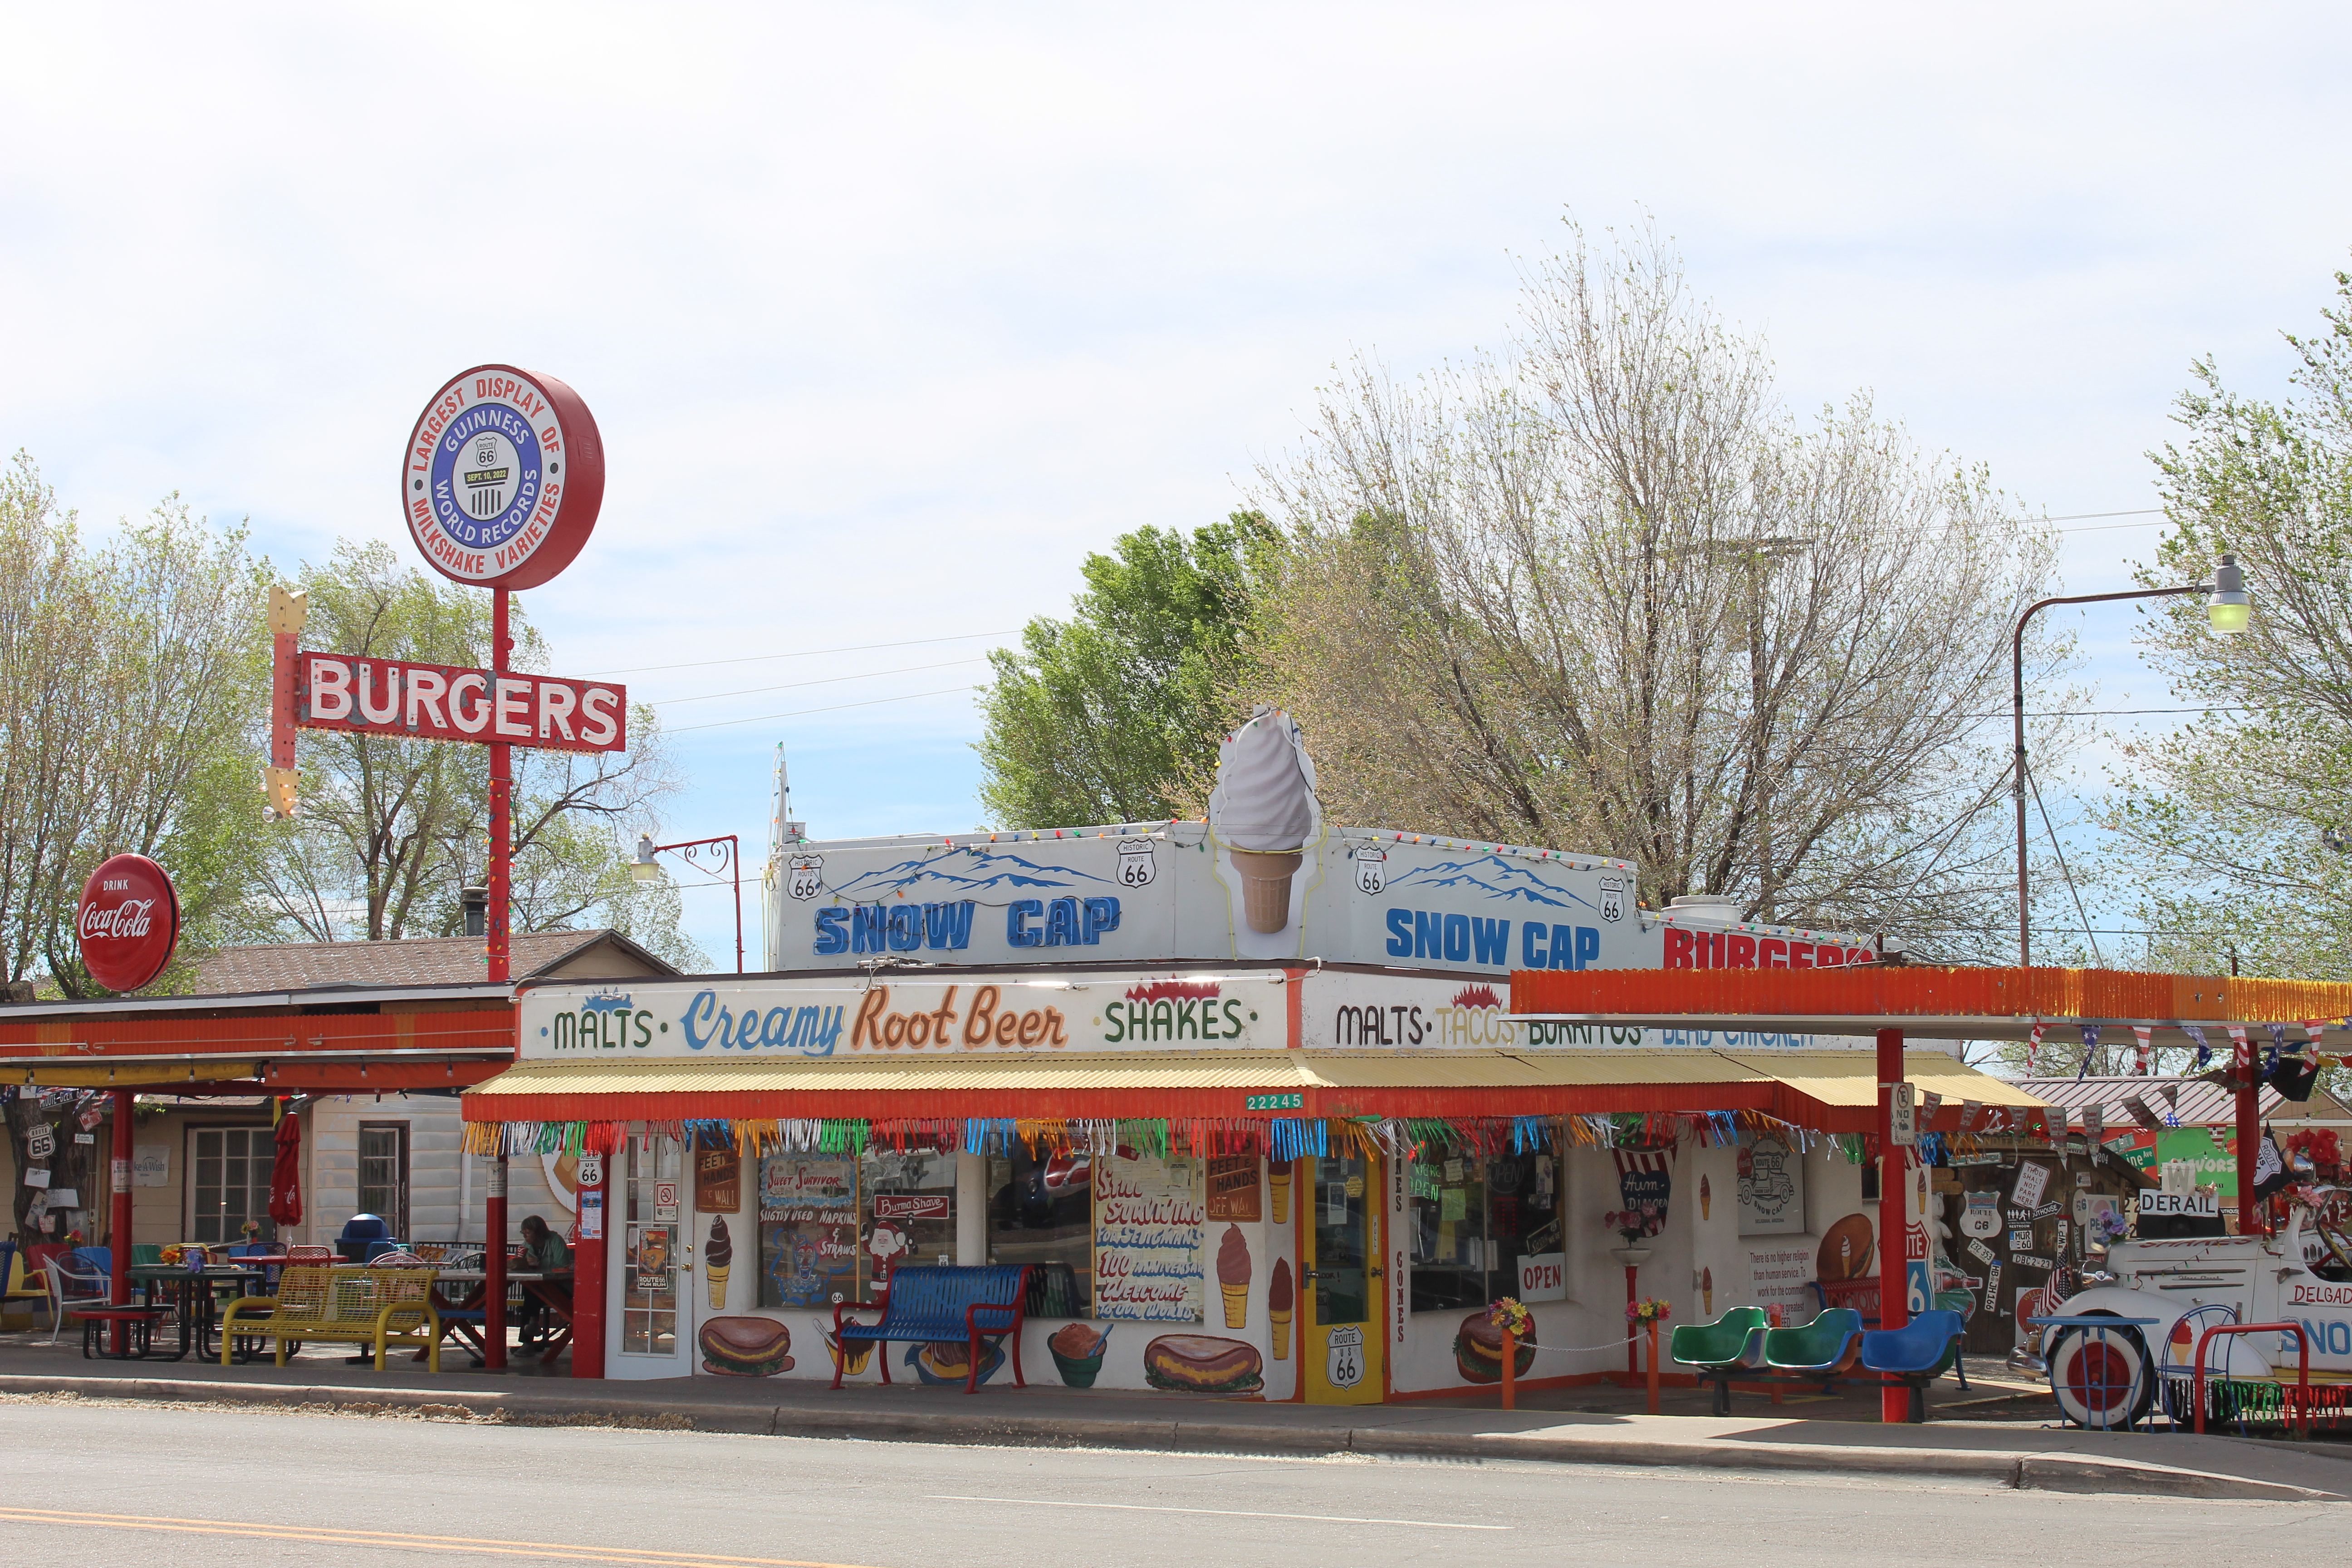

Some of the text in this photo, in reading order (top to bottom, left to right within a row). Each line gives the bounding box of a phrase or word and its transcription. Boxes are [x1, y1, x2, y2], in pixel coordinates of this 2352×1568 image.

[412, 378, 560, 472] LARGEST DISPLAY OF
[445, 409, 529, 452] GUINNESS
[479, 451, 494, 463] 66
[467, 470, 506, 482] SEPT. 10, 2022
[436, 469, 537, 544] WORLD RECORDS
[413, 483, 559, 573] MILKSHAKE VARIETIES
[310, 659, 618, 745] BURGERS
[1123, 843, 1149, 851] HISTORIC
[1360, 851, 1381, 859] HISTORIC
[1127, 856, 1145, 864] ROUTE
[1125, 865, 1147, 883] 66
[1362, 871, 1380, 890] 66
[103, 879, 128, 891] DRINK
[795, 878, 814, 897] 66
[80, 898, 156, 939] Coca-Cola
[1604, 901, 1619, 919] 66
[813, 896, 1122, 956] SNOW CAP
[1386, 908, 1599, 971] SNOW CAP
[554, 984, 1242, 1056] MALTS Creamy Root Beer SHAKES
[1336, 1005, 1423, 1045] MALTS
[1436, 1007, 1515, 1045] TACOS
[1248, 1094, 1301, 1110] 22245
[1897, 1110, 1909, 1118] NO
[32, 1137, 50, 1154] 66
[698, 1153, 725, 1171] FEET
[1755, 1156, 1780, 1168] ROUTE 66
[2125, 1150, 2153, 1167] ine Ave
[2262, 1144, 2277, 1168] ROUTE
[582, 1168, 598, 1181] 66
[1210, 1156, 1254, 1176] FEET &
[1489, 1163, 1521, 1182] OPEN
[2027, 1166, 2043, 1177] THOU
[704, 1166, 736, 1186] HANDS
[767, 1166, 841, 1190] SWEET SURVIVOR
[1217, 1170, 1258, 1193] HANDS
[2022, 1172, 2042, 1185] SHALT
[2167, 1165, 2190, 1192] W
[2019, 1187, 2036, 1199] PARK
[2024, 1181, 2037, 1190] NOT
[715, 1190, 736, 1205] WALL
[880, 1197, 944, 1216] Burma Shave
[1208, 1197, 1227, 1214] OFF
[2017, 1194, 2034, 1206] HERE
[2142, 1194, 2216, 1214] DERAIL
[1104, 1198, 1204, 1226] SURVIVING
[1754, 1200, 1783, 1215] SNOW CAP
[791, 1210, 814, 1222] USED
[818, 1210, 857, 1225] NAPKINS
[1096, 1226, 1118, 1248] FOR
[2015, 1230, 2030, 1240] MÜR
[820, 1241, 857, 1259] STRAWS
[1970, 1240, 1993, 1261] 232 353
[2021, 1240, 2032, 1249] 60
[1099, 1251, 1132, 1278] 100
[1750, 1250, 1809, 1264] There is no higher religion
[2015, 1254, 2031, 1265] DBC
[1524, 1264, 1561, 1290] OPEN
[1754, 1266, 1806, 1280] than human service. To
[1101, 1279, 1187, 1303] WELCOME
[1757, 1285, 1769, 1297] work
[1785, 1286, 1806, 1295] common
[1907, 1269, 1925, 1312] 6
[1985, 1265, 1999, 1310] HB JH 166
[2023, 1290, 2041, 1301] WELC
[832, 1294, 843, 1302] 66
[1396, 1251, 1404, 1343] CONES
[1113, 1303, 1142, 1319] OUR
[1144, 1303, 1193, 1321] WORLD
[1785, 1301, 1805, 1315] greatest
[1334, 1333, 1356, 1344] ROUTE
[1337, 1357, 1356, 1381] 66
